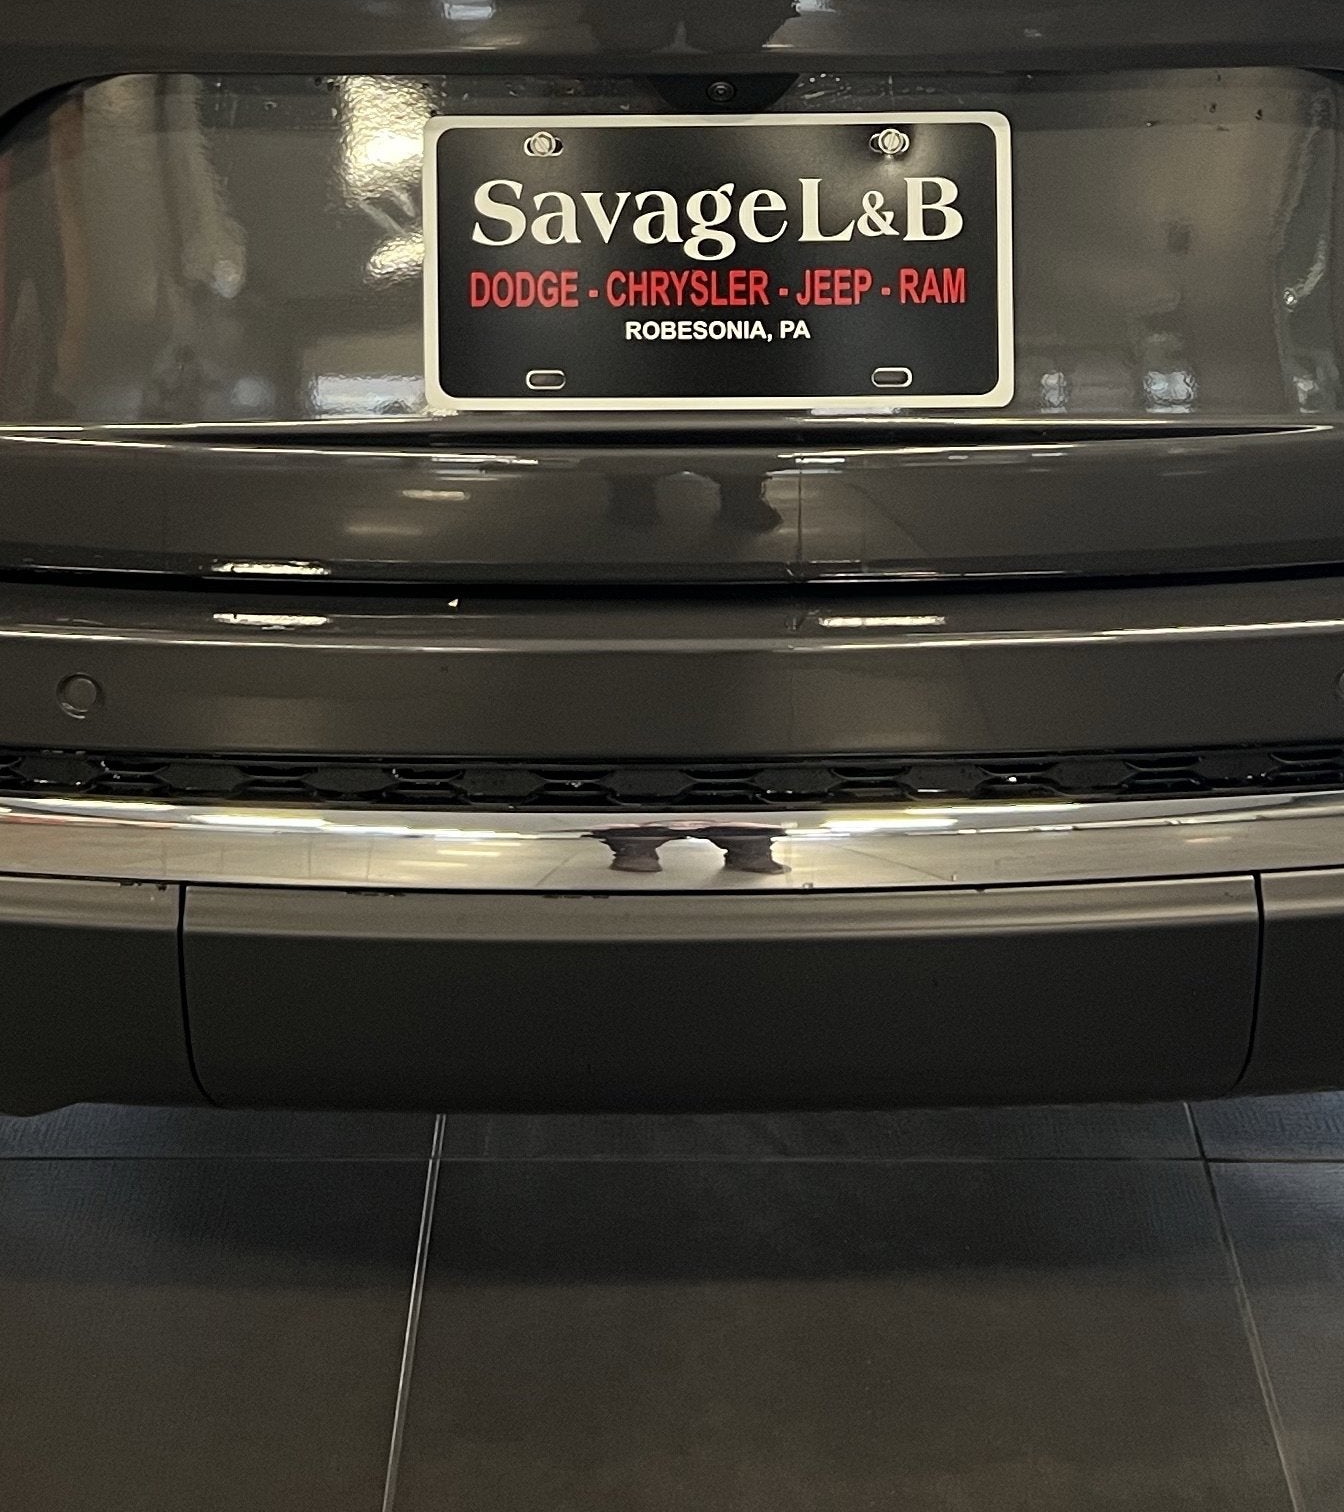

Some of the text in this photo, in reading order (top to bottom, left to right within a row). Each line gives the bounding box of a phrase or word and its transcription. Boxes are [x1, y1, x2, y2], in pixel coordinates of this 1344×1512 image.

[470, 271, 579, 308] DODGE
[606, 268, 769, 307] CHRYSLER
[795, 269, 872, 305] JEEP
[899, 267, 967, 304] RAM
[624, 320, 811, 343] ROBESONIA, PA
